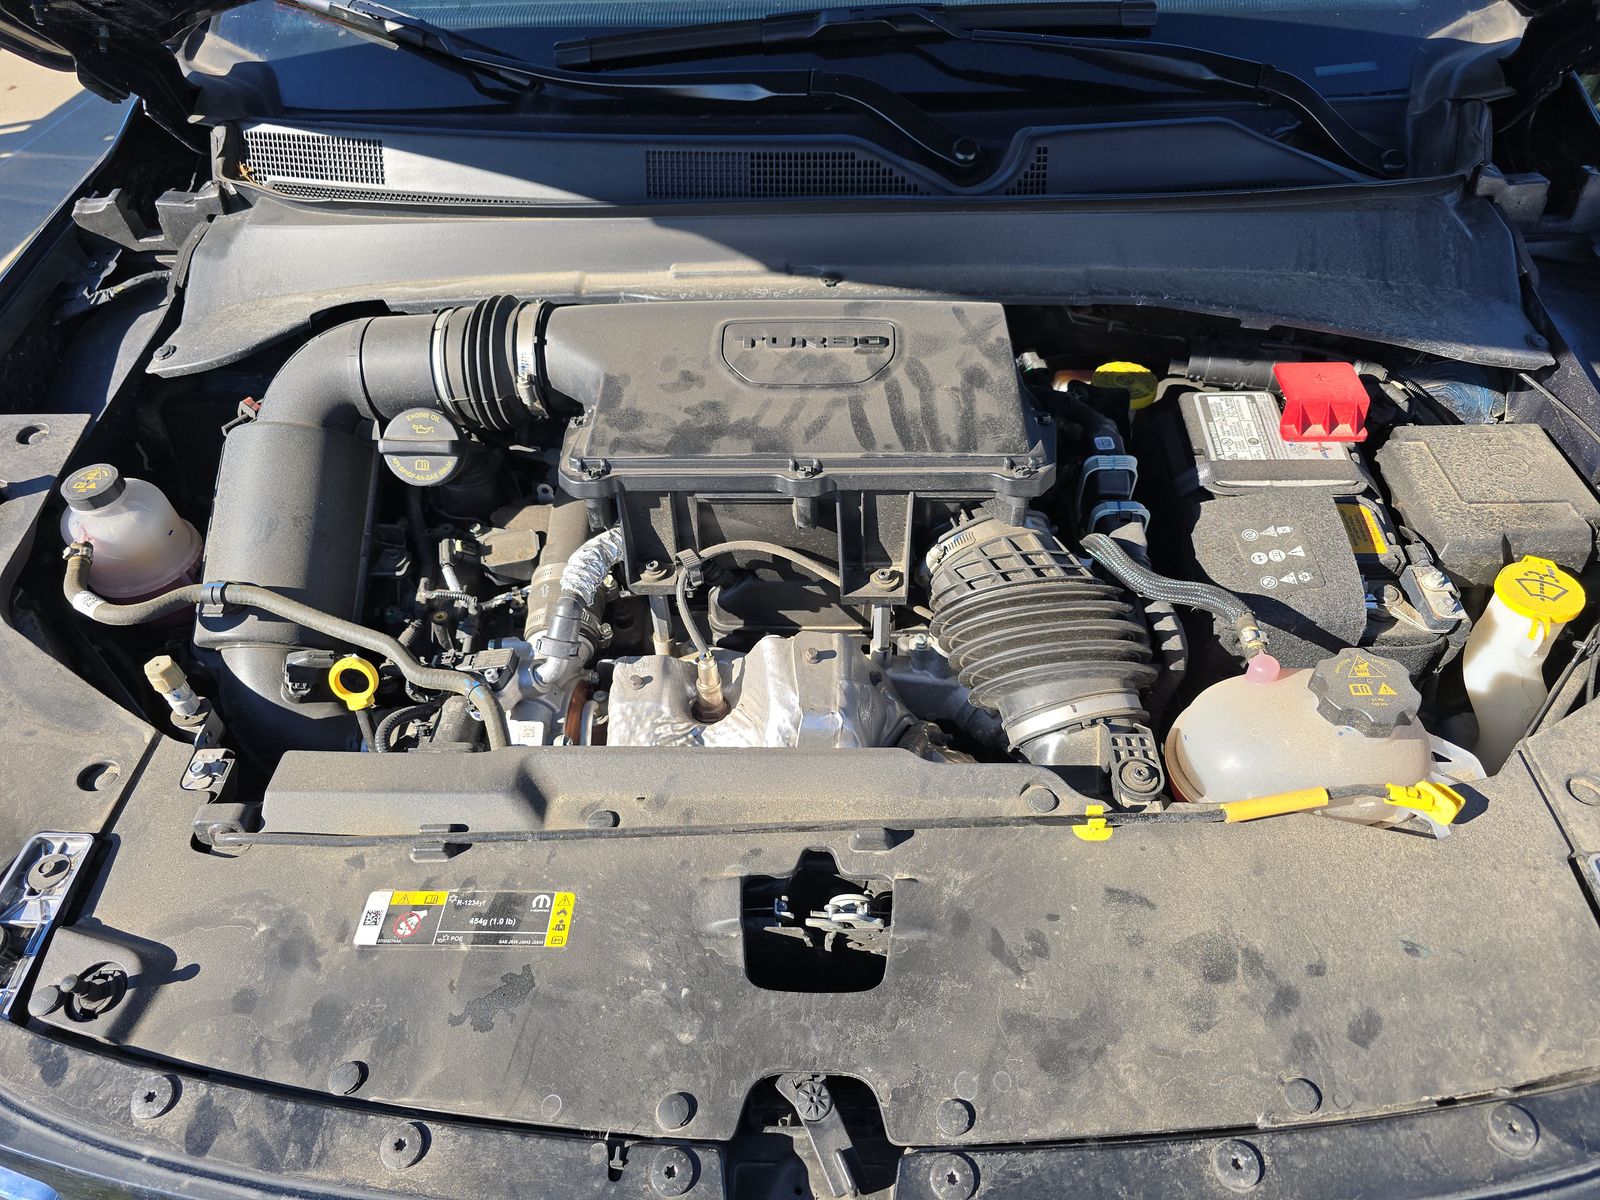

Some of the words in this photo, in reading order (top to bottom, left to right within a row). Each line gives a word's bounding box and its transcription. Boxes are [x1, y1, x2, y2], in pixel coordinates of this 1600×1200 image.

[732, 335, 890, 350] TURBO
[406, 411, 430, 421] ENGINE
[430, 413, 441, 423] OIL
[456, 899, 487, 907] R-1234yf
[469, 917, 488, 926] 454g
[489, 917, 504, 926] (1.0
[505, 917, 517, 926] lb)
